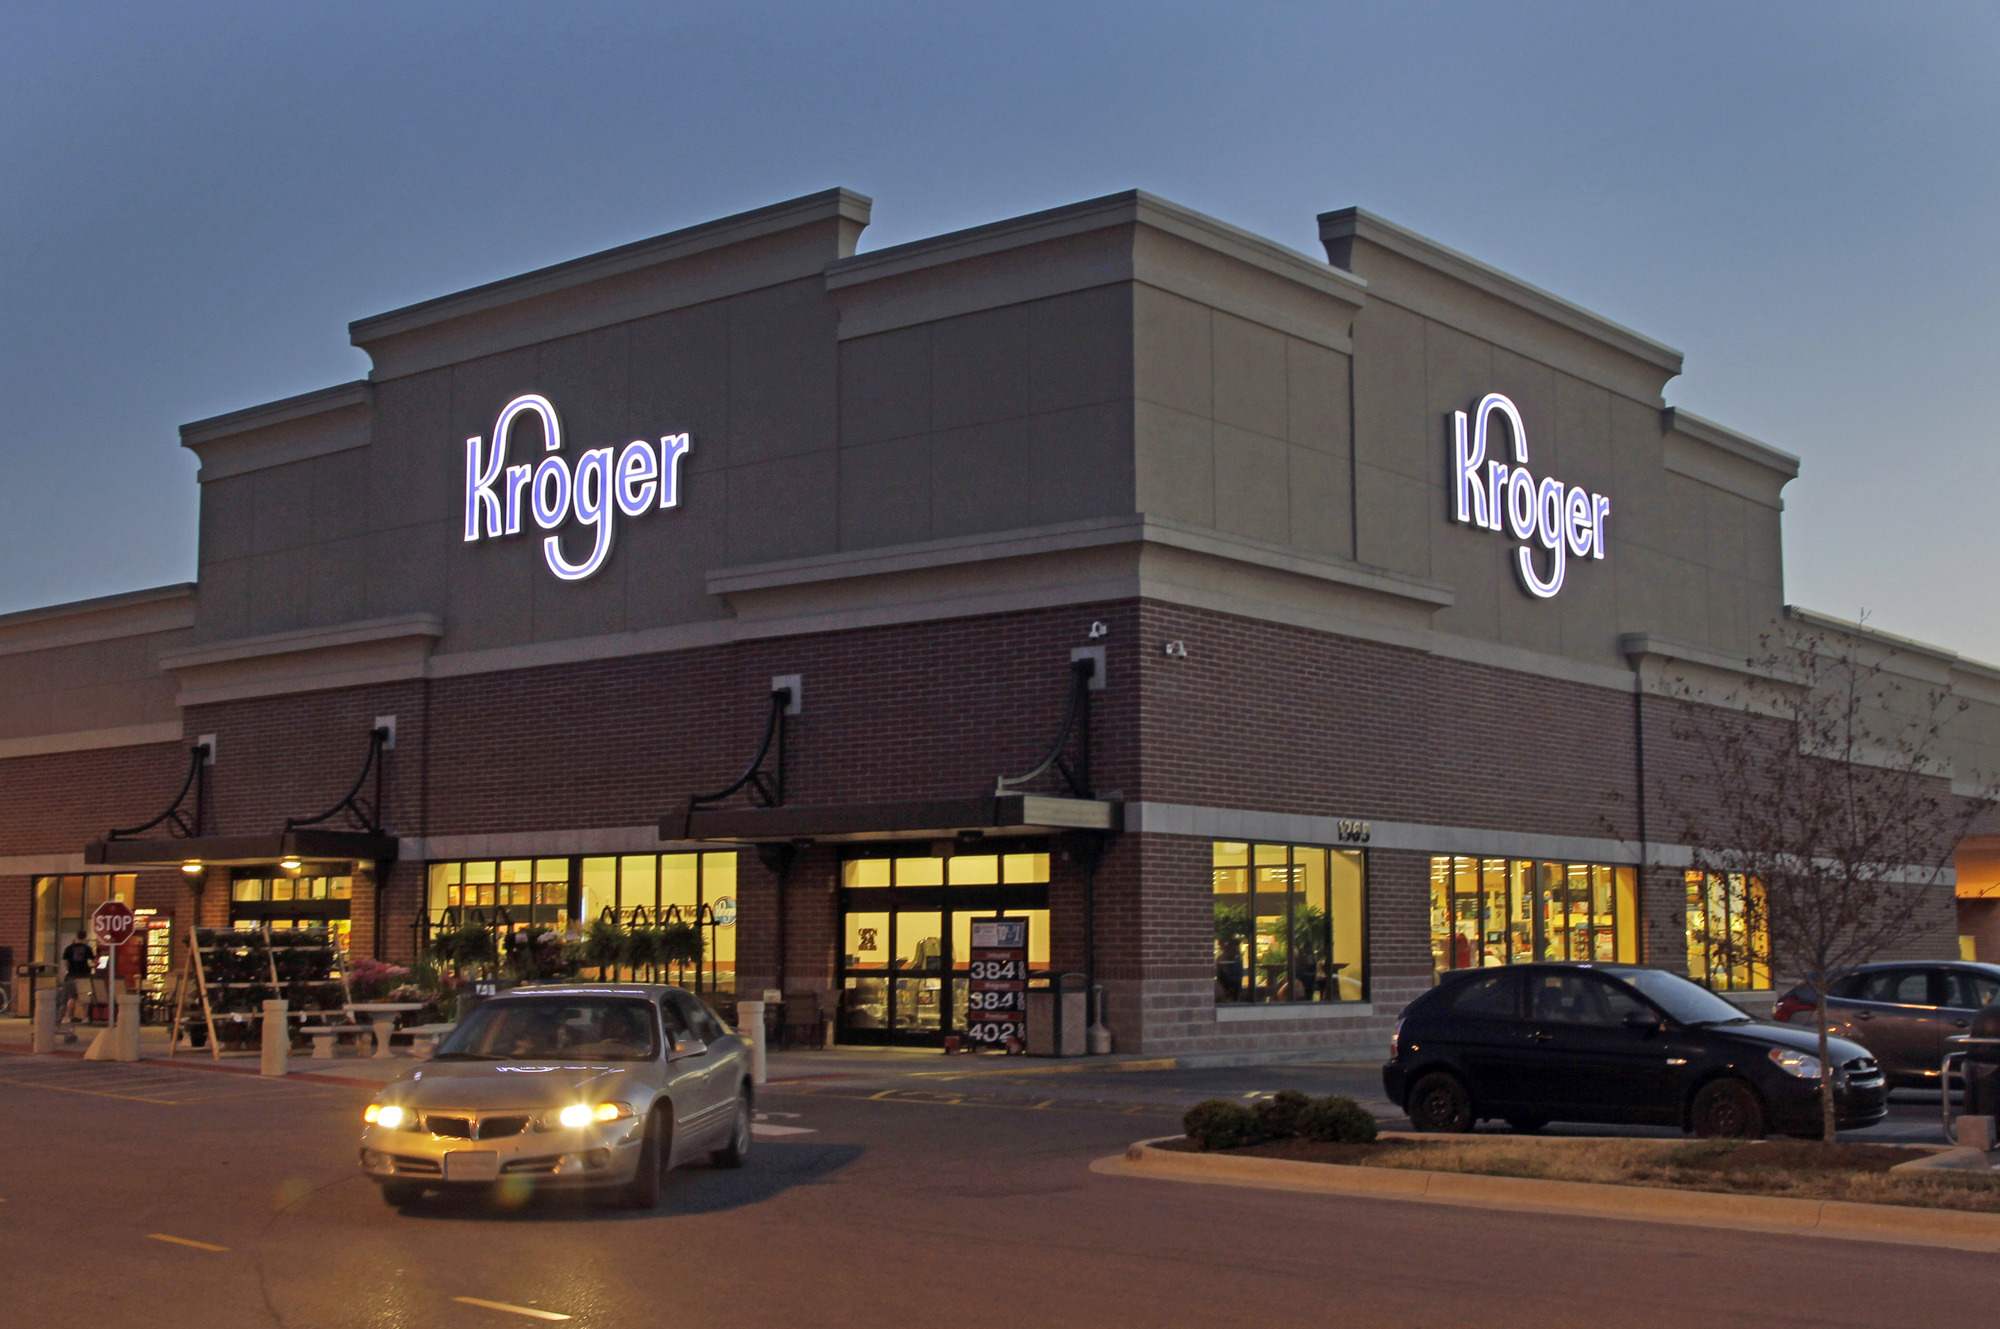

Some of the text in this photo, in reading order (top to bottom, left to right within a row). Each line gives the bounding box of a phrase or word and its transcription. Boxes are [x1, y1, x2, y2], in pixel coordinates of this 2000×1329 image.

[463, 393, 690, 580] Kroger
[1454, 392, 1610, 598] Kroger
[95, 915, 132, 932] STOP
[971, 961, 1015, 979] 384
[970, 992, 1014, 1010] 384
[969, 1023, 1014, 1042] 402
